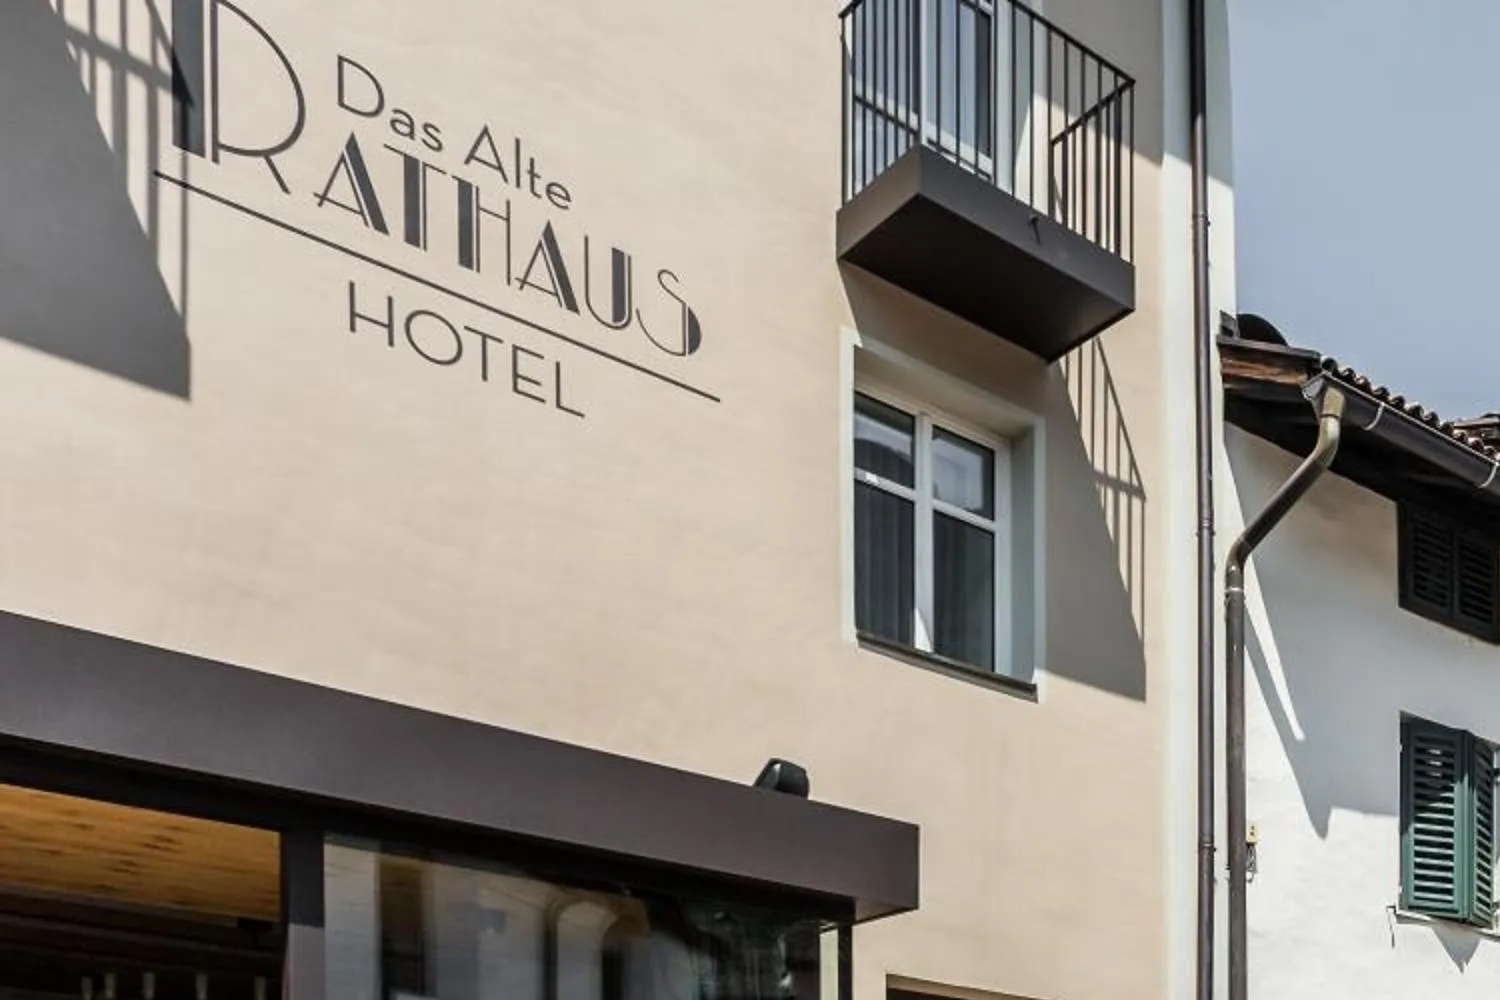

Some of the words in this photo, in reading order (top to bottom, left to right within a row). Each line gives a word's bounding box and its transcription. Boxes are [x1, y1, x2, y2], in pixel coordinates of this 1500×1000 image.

[171, 0, 702, 357] RATHAUS
[336, 54, 444, 154] Das
[464, 124, 572, 211] Alte
[348, 280, 586, 418] HOTEL
